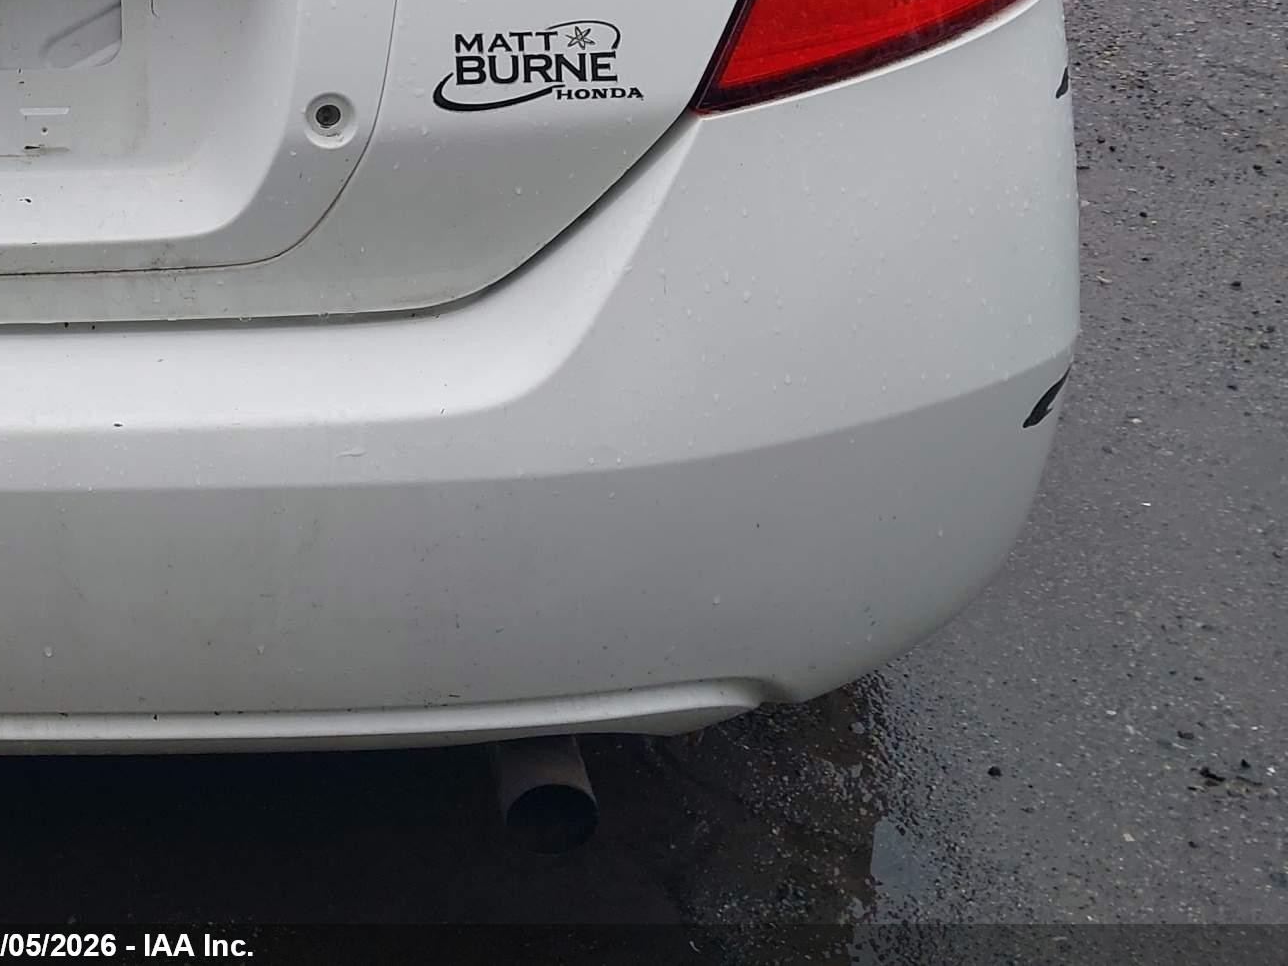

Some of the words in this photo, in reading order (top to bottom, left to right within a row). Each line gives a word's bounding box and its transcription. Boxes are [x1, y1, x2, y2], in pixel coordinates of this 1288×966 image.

[455, 31, 558, 53] MATT
[456, 51, 618, 85] BURNE
[556, 86, 644, 101] HONDA
